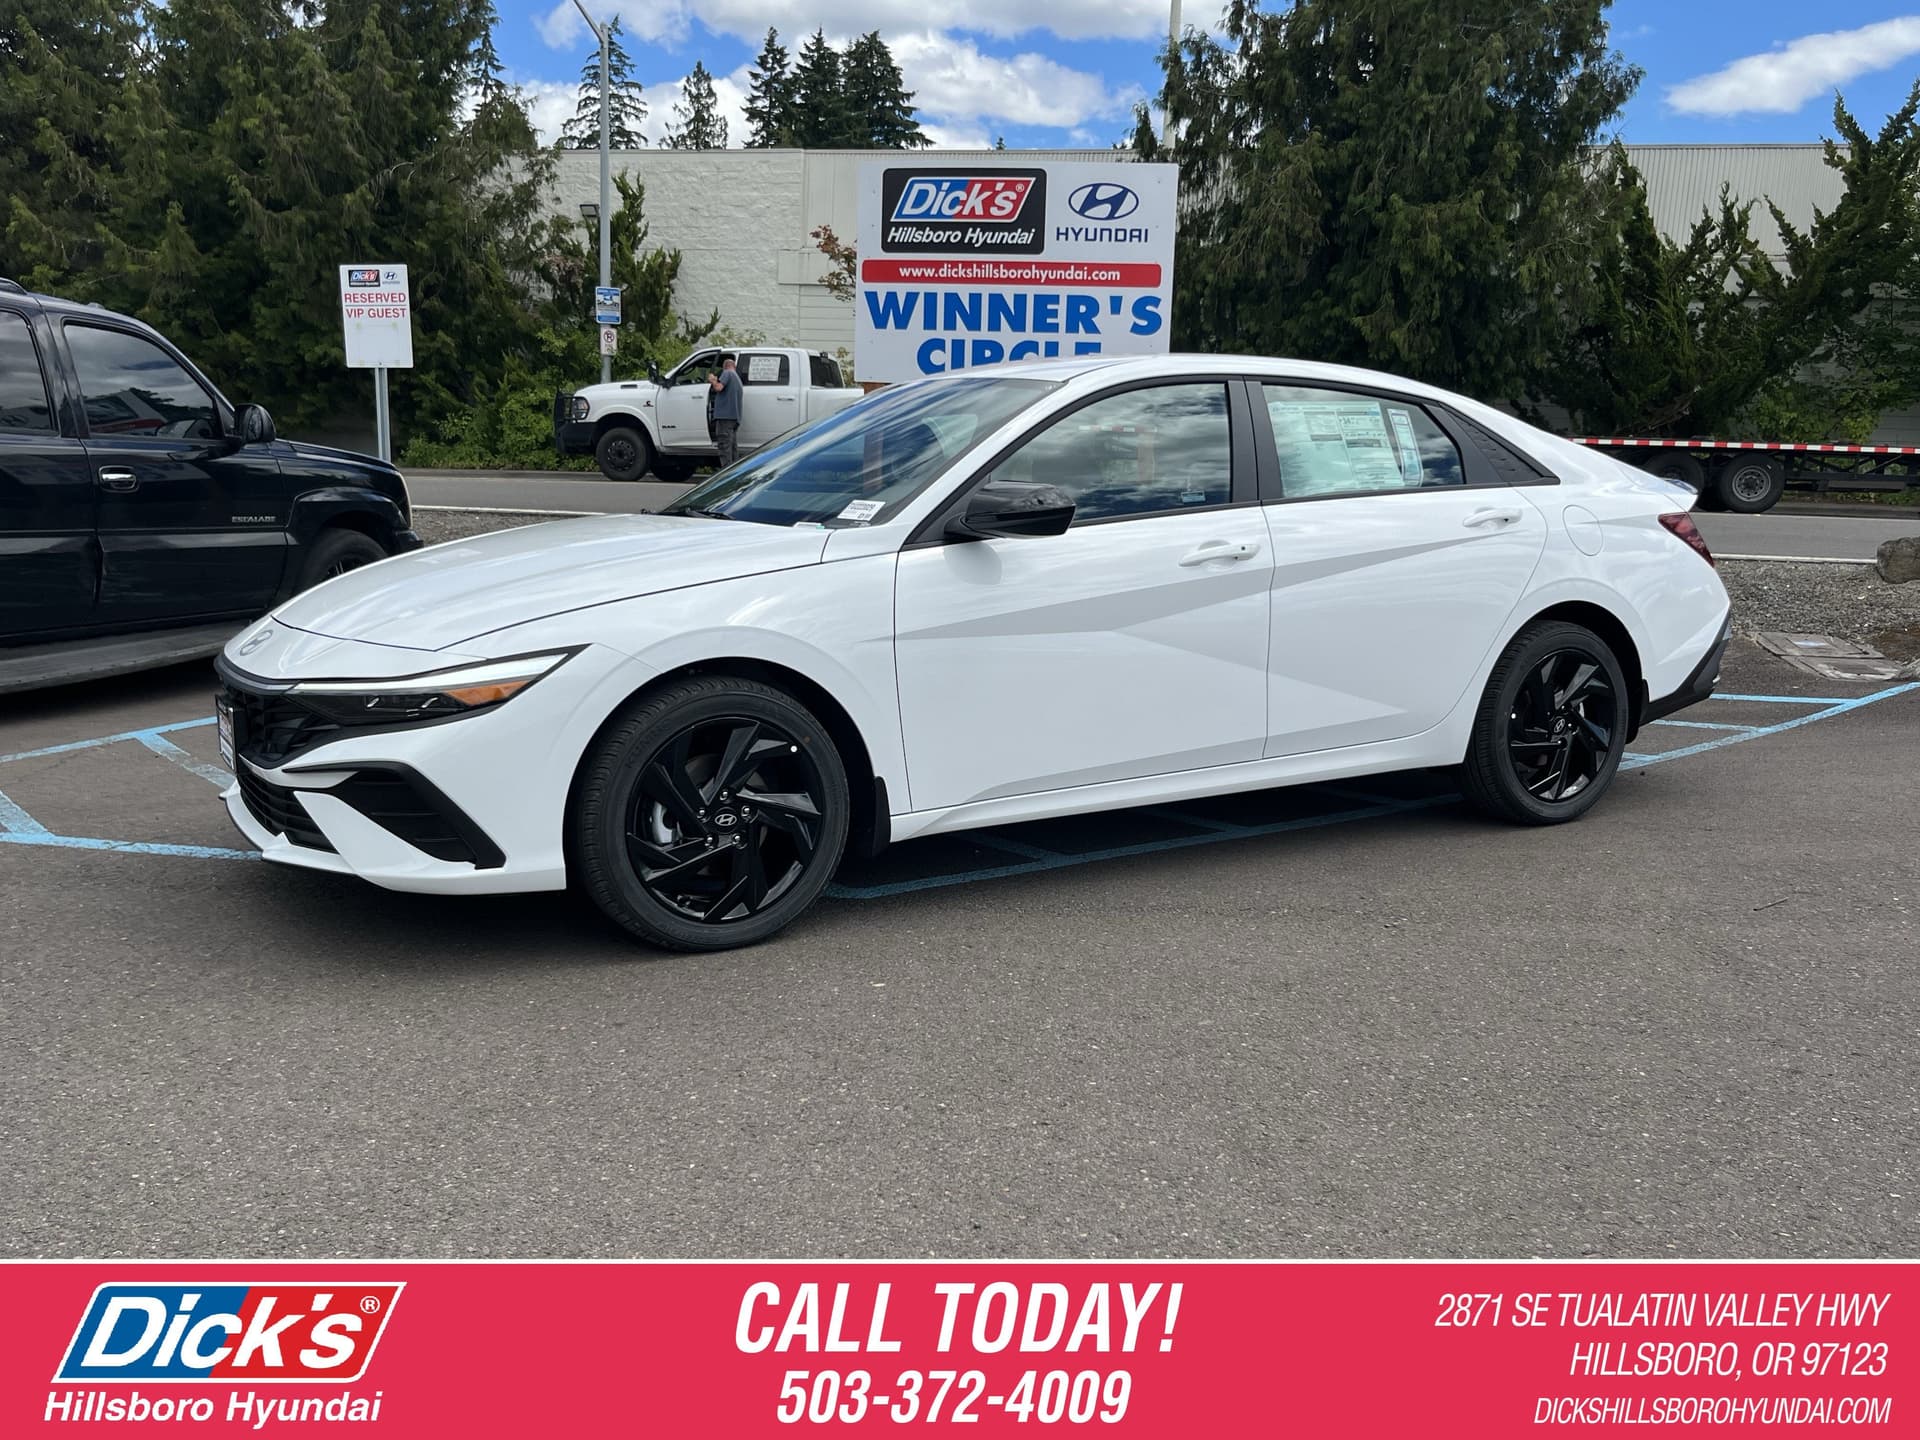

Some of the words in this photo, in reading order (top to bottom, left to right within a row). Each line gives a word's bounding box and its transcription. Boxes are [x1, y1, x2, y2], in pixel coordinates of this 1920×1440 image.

[902, 181, 1017, 217] Dick's
[887, 226, 962, 244] Hillsboro
[964, 227, 1036, 247] Hyundai
[1056, 226, 1149, 243] HYUNDAI
[899, 263, 1121, 284] www.dickshillsborohyundai.com
[344, 293, 406, 303] RESERVED
[346, 308, 365, 318] VIP
[367, 307, 407, 318] GUEST
[864, 290, 1163, 336] WINNER'S
